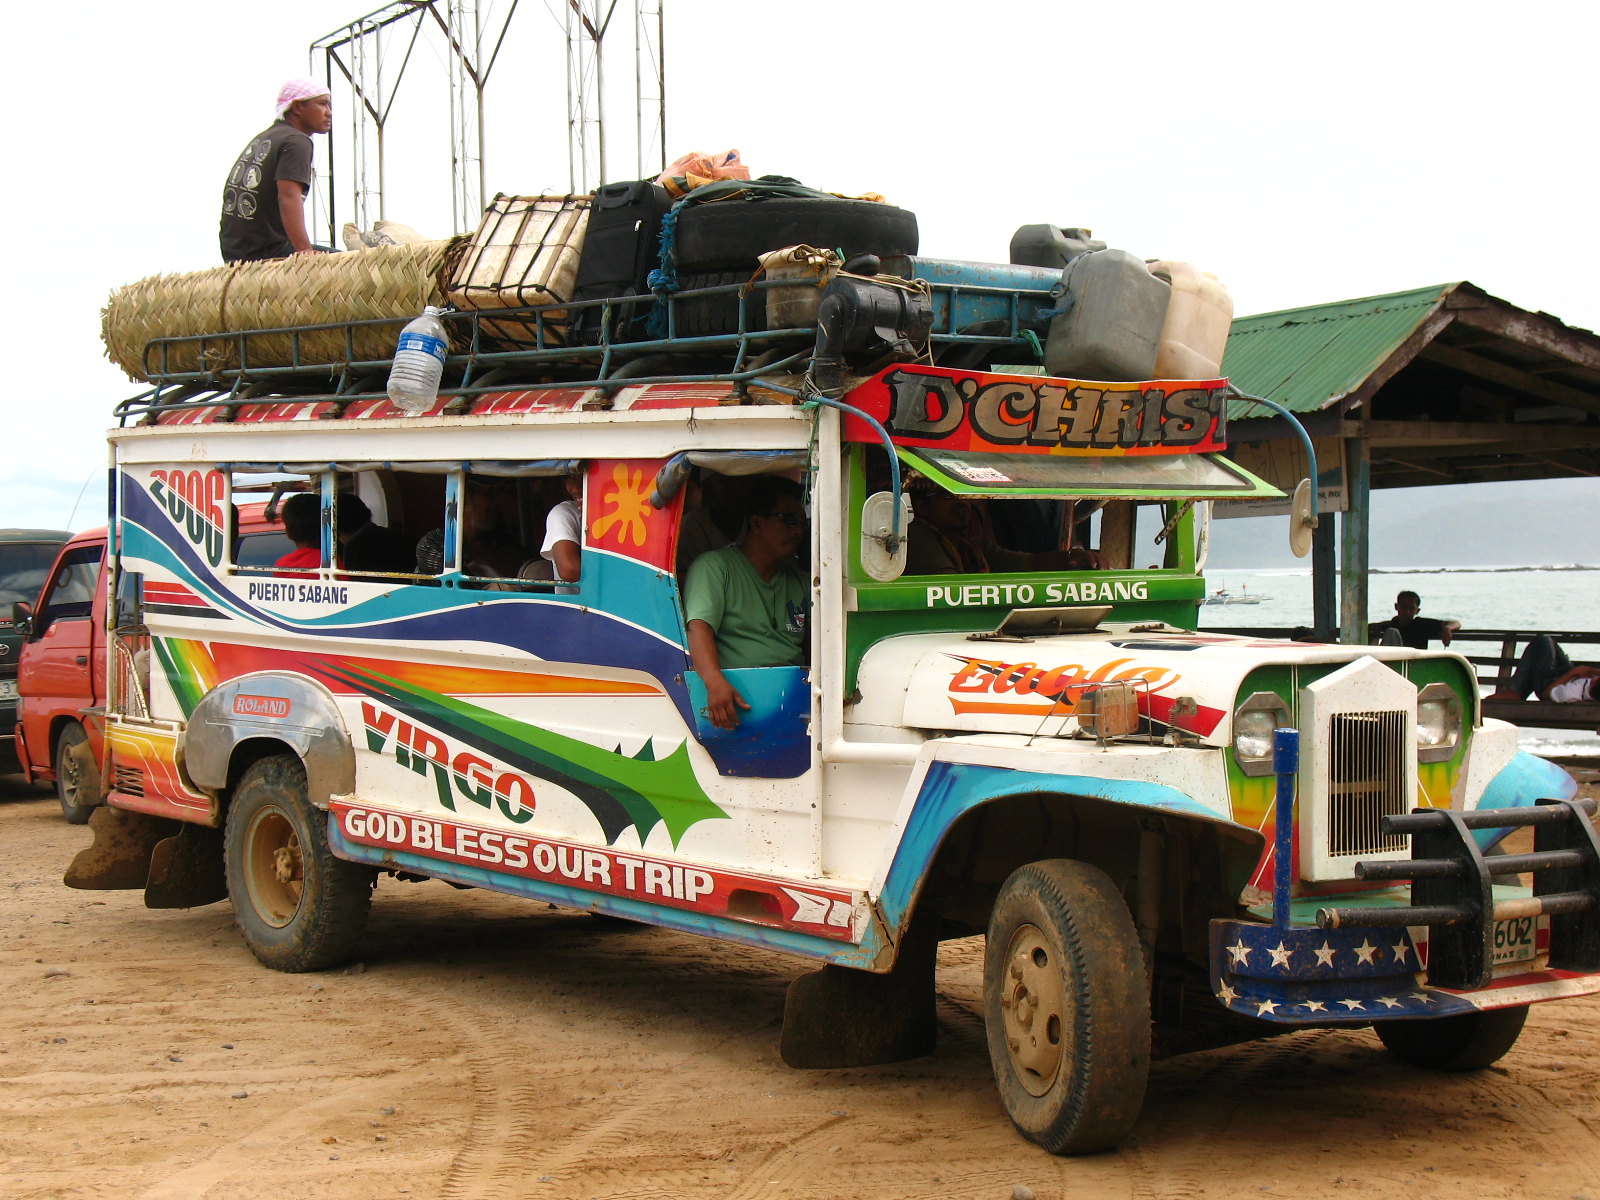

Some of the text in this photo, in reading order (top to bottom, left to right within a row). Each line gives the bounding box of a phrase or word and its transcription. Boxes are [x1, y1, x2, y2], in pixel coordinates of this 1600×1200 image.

[150, 470, 224, 568] 2006
[249, 582, 348, 605] PUERTO SABANG
[927, 581, 1148, 607] PUERTO SABANG
[236, 697, 287, 715] ROLAND
[361, 700, 536, 824] VIRGO
[345, 809, 714, 902] GOD BLESS OUR TRIP
[1494, 917, 1531, 948] 602
